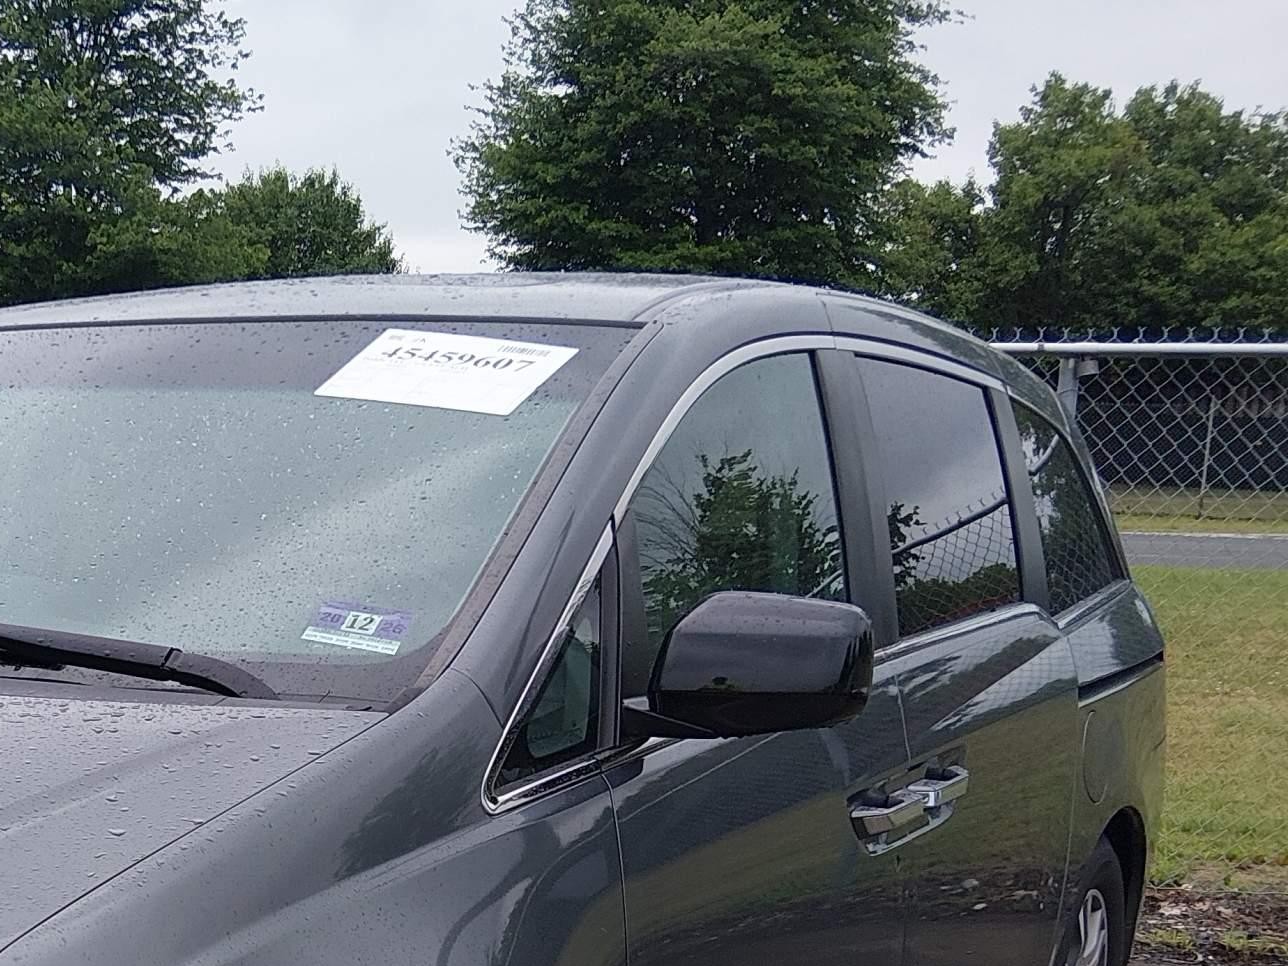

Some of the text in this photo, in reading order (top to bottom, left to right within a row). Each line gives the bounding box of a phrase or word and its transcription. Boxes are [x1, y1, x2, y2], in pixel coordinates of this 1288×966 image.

[381, 346, 537, 373] 45459607
[319, 611, 343, 624] 20
[345, 614, 376, 632] 12
